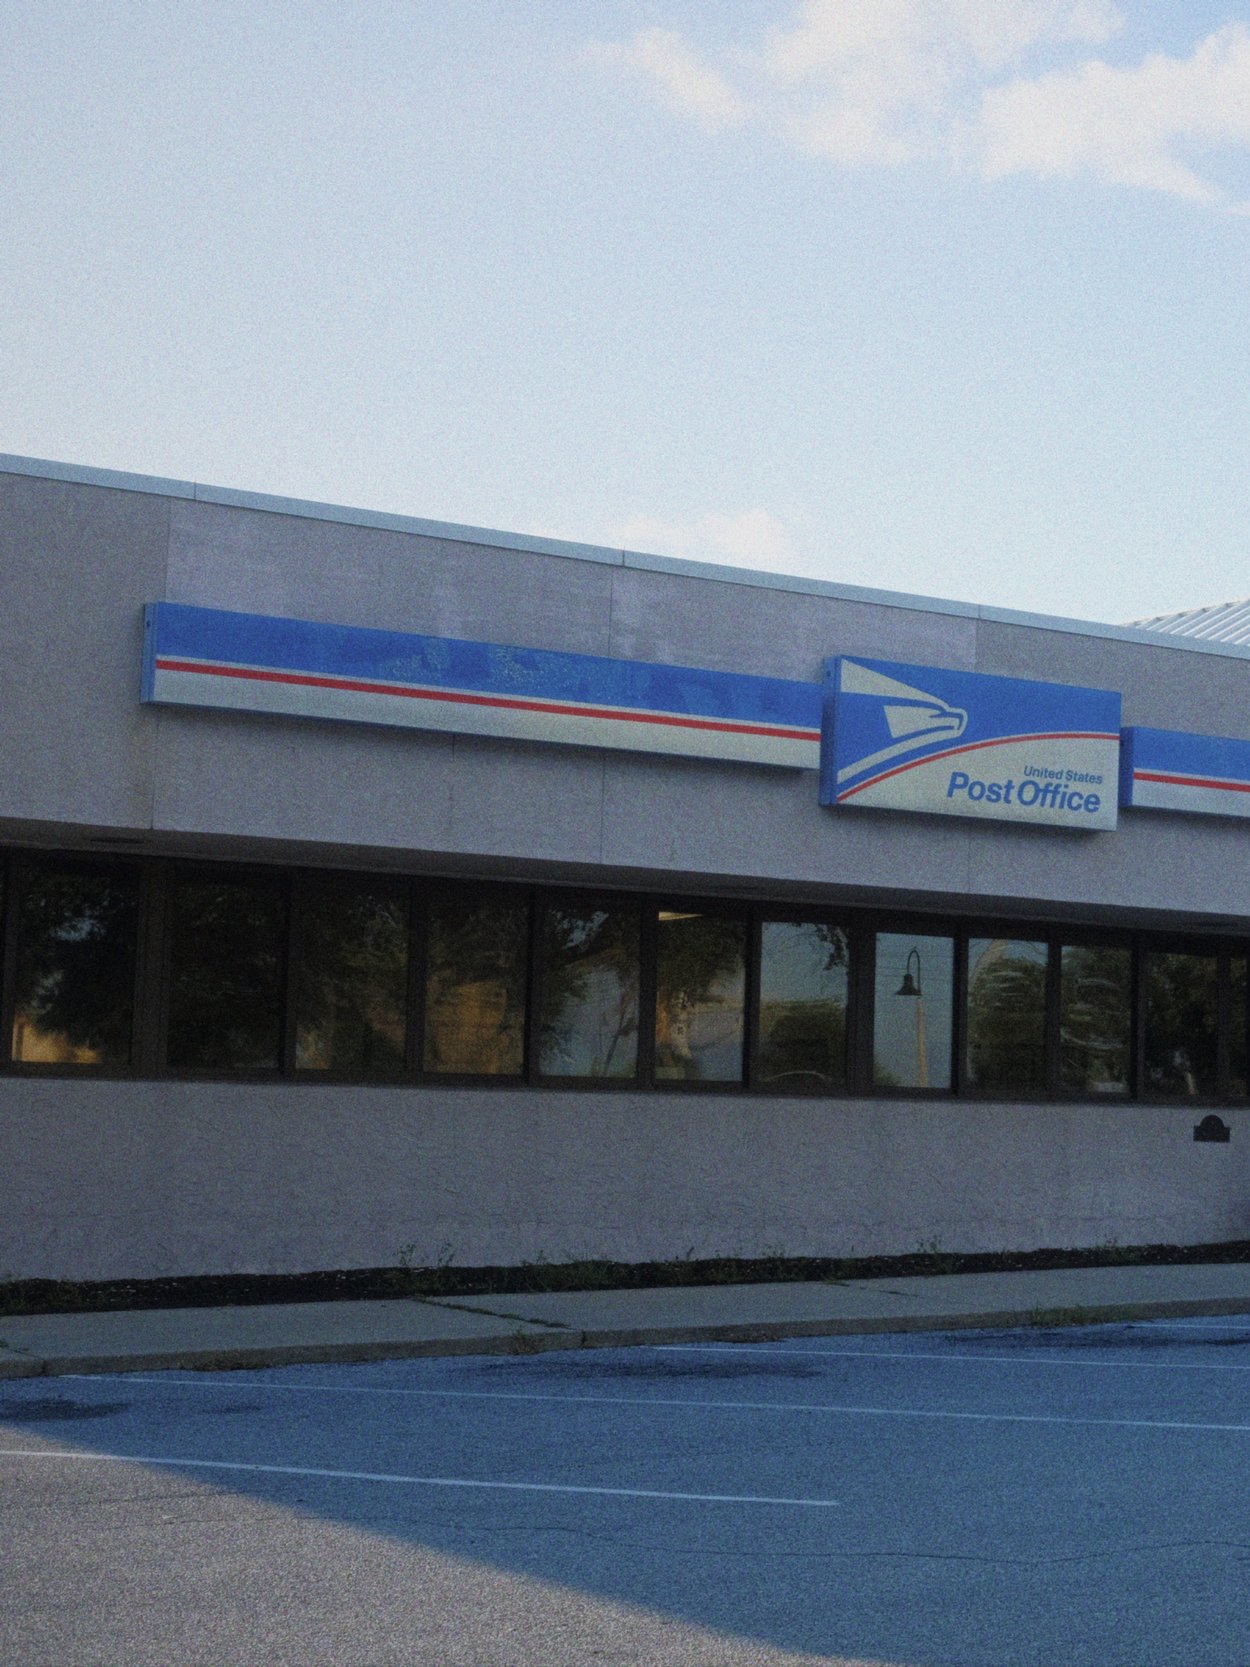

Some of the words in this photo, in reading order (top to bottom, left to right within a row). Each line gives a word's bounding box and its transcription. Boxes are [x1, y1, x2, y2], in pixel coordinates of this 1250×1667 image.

[1023, 765, 1064, 780] United
[1065, 769, 1103, 785] States
[946, 771, 1015, 805] Post
[1017, 780, 1101, 813] Office
